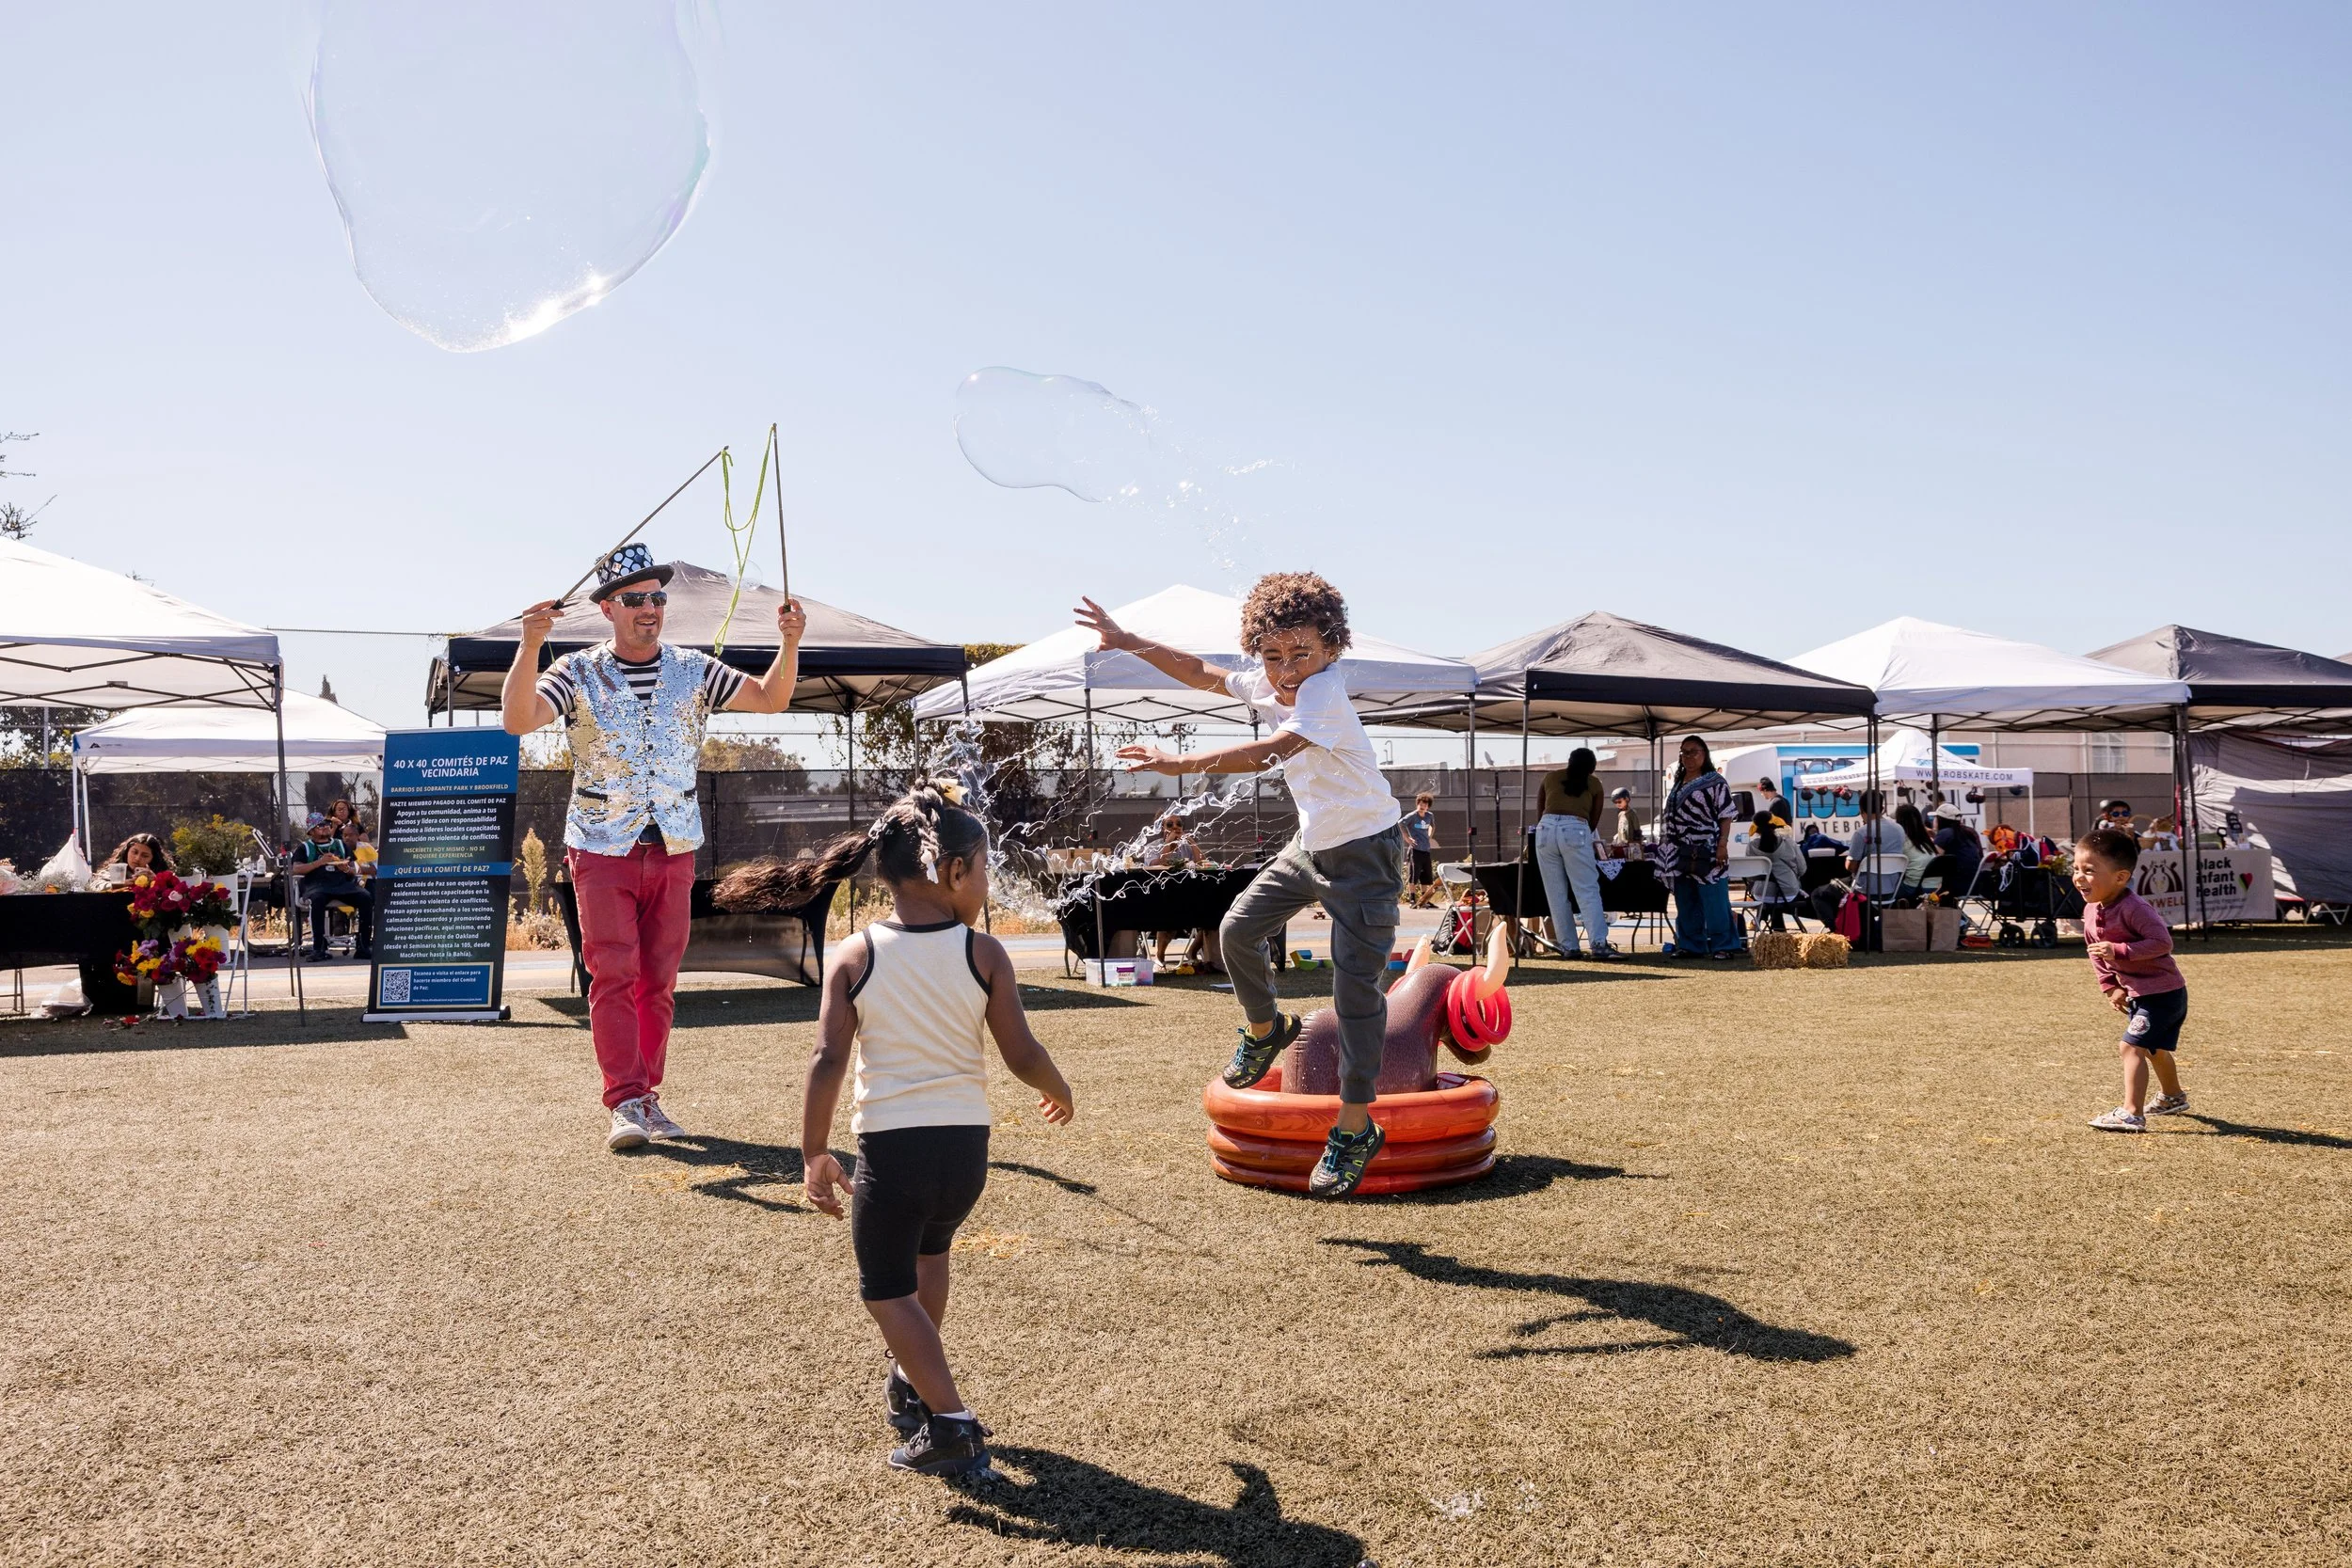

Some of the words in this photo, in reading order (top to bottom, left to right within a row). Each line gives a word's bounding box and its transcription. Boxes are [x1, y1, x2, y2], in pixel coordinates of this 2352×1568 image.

[394, 760, 405, 769] 40
[407, 759, 414, 768] X
[416, 759, 427, 768] 40
[432, 755, 473, 767] COMITÉS
[476, 757, 488, 766] DE
[490, 756, 508, 765] PAZ
[422, 768, 479, 777] VECINDARIA
[1916, 770, 2013, 780] WW.ROBSKATE.COM
[450, 816, 497, 825] responsabilidad
[466, 825, 500, 833] capacitados
[394, 866, 412, 875] ¿QUÉ
[434, 864, 461, 873] COMITÉ
[441, 889, 474, 897] capacitados
[2196, 883, 2236, 897] health
[454, 915, 491, 923] promoviendo
